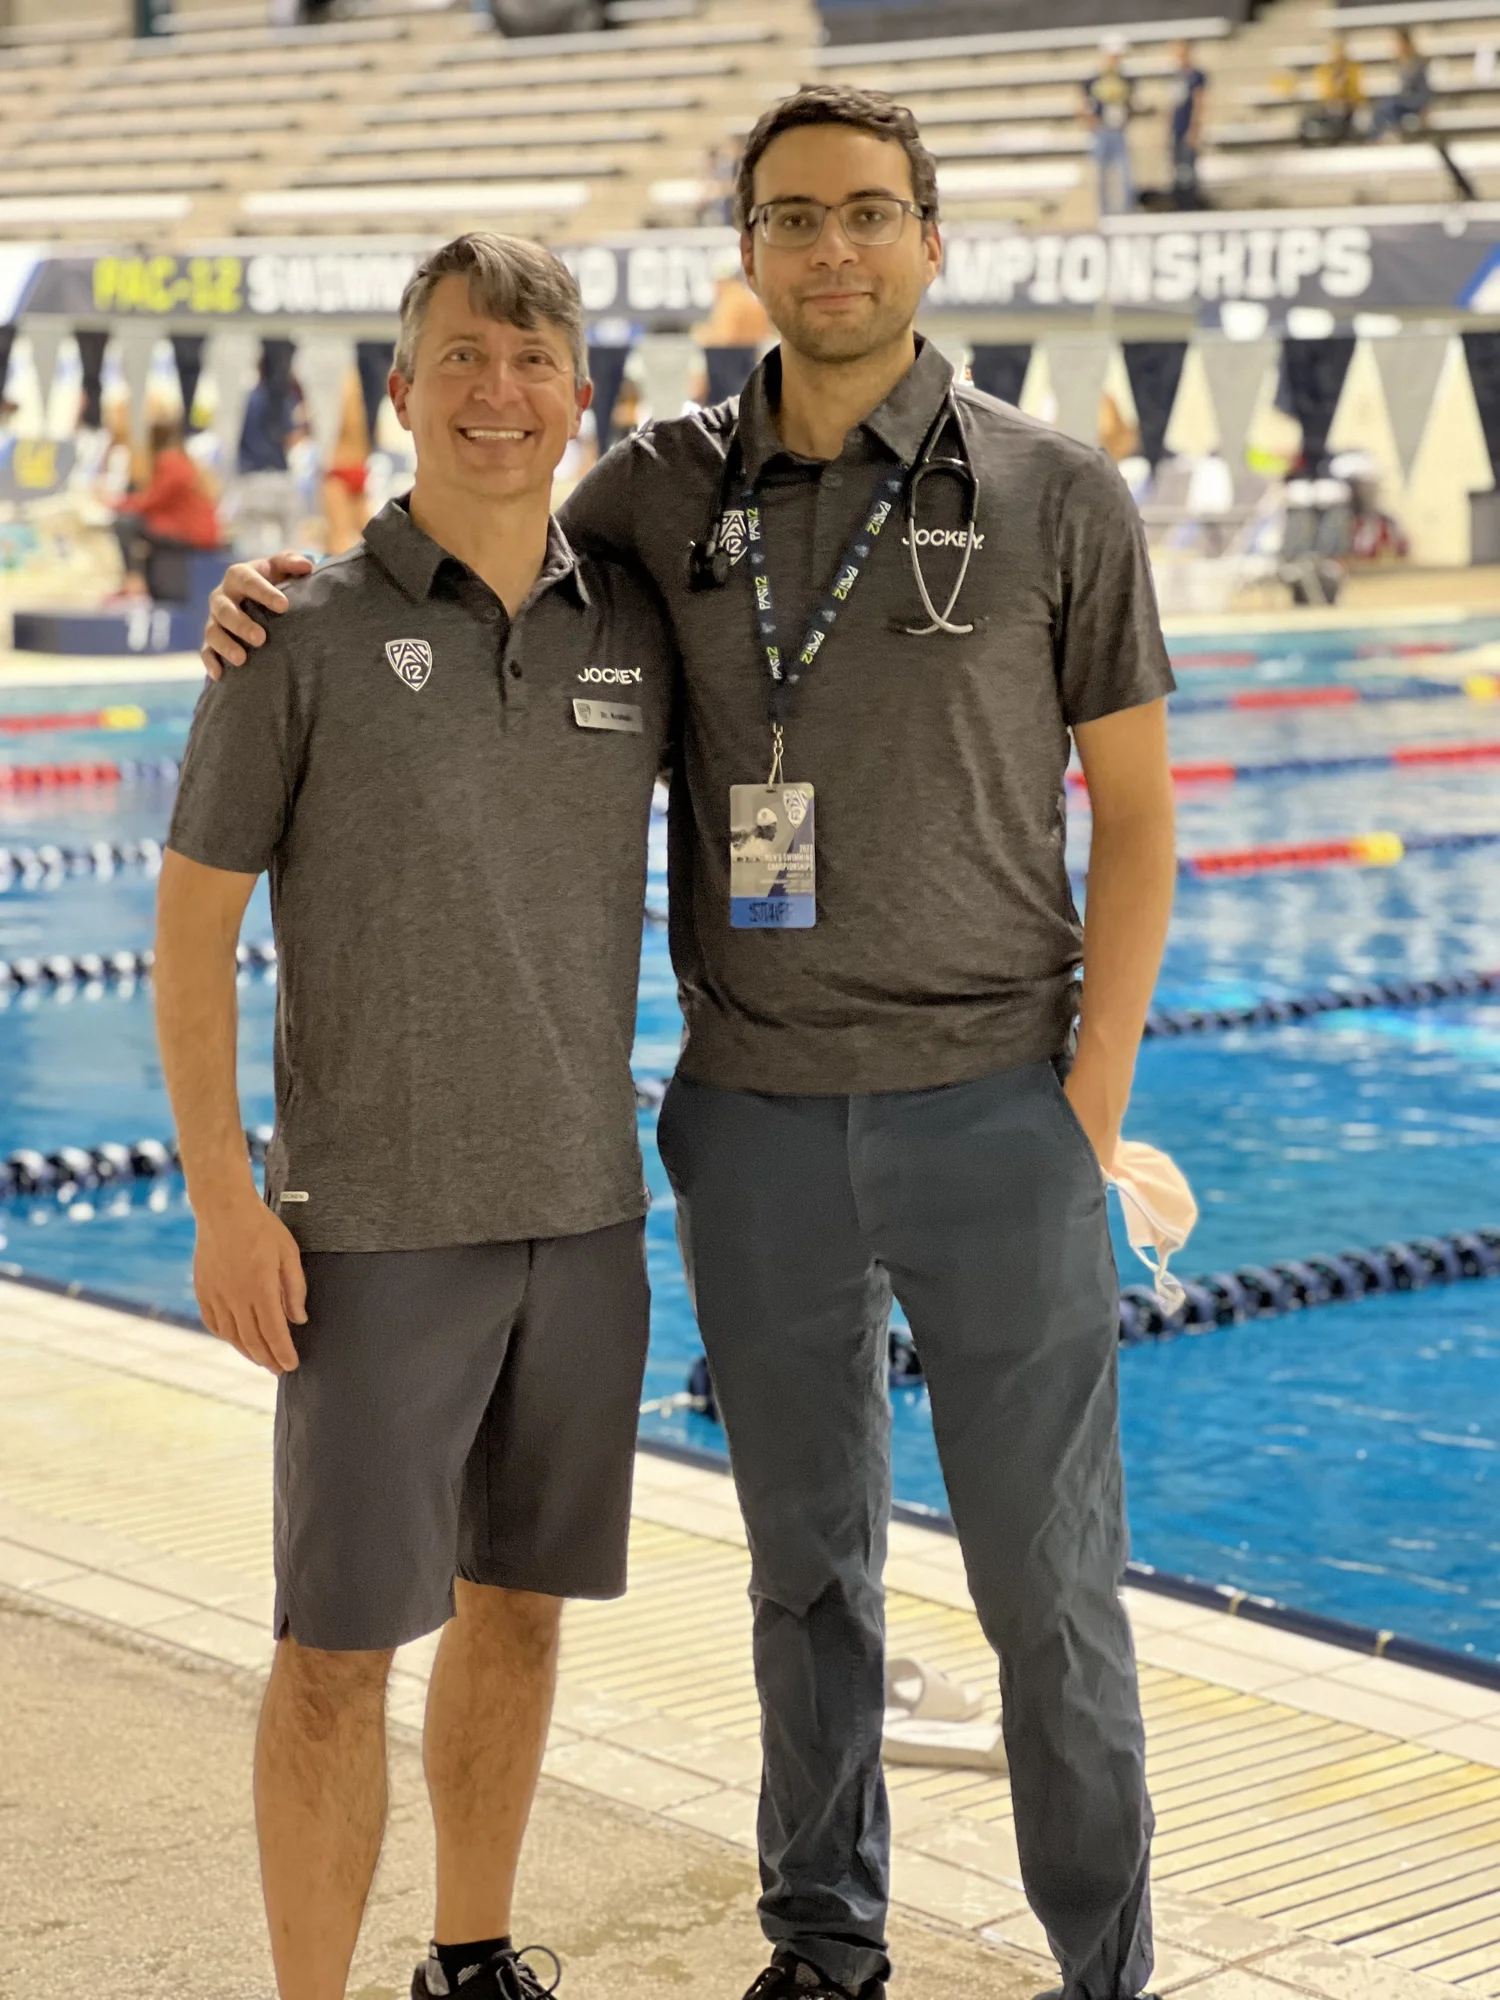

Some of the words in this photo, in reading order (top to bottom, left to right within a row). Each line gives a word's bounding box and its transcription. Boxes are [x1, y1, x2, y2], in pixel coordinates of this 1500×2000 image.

[93, 256, 243, 312] PAC-12
[928, 227, 1372, 304] MPIONSHIPS
[726, 538, 742, 554] 12
[405, 665, 424, 680] 12
